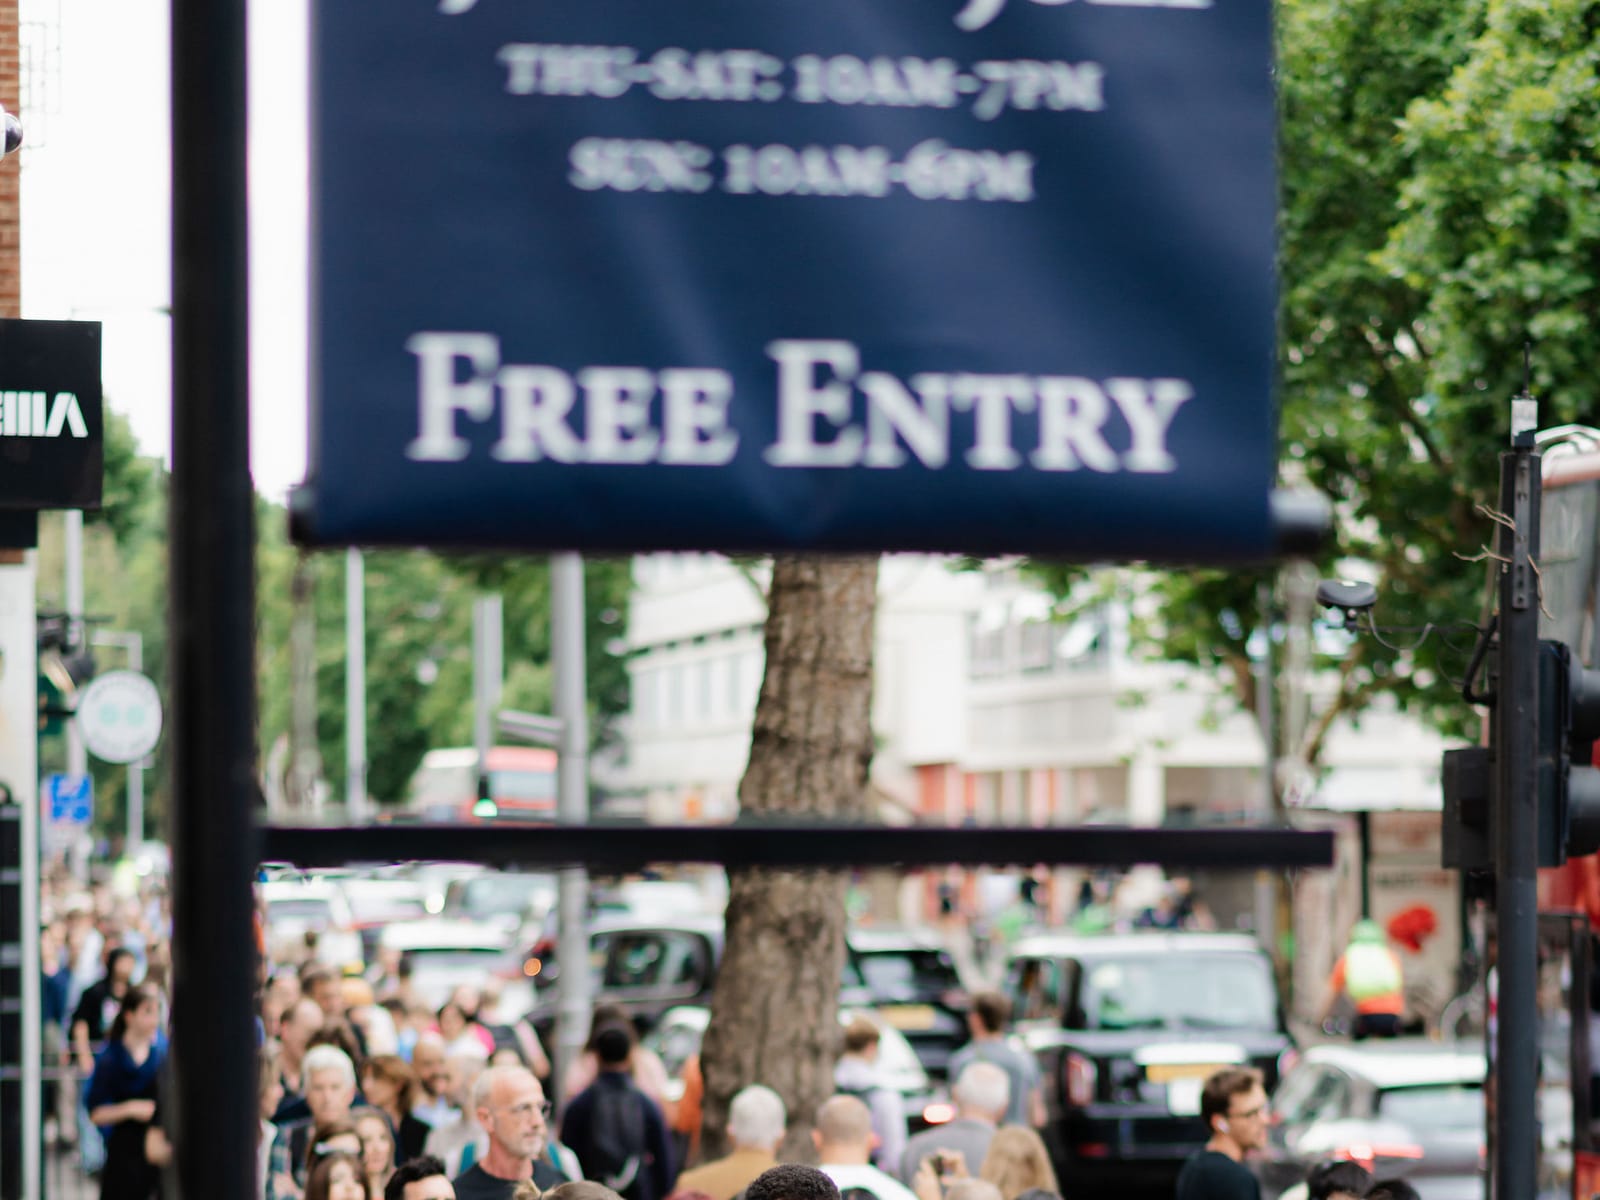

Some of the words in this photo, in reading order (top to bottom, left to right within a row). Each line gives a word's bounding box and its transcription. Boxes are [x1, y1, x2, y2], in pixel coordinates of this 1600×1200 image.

[793, 54, 1104, 120] 10AM-7PM
[569, 137, 712, 193] SUN:
[721, 138, 1034, 202] 10AM-6PM
[406, 331, 739, 465] FREE
[763, 339, 1194, 473] ENTRY
